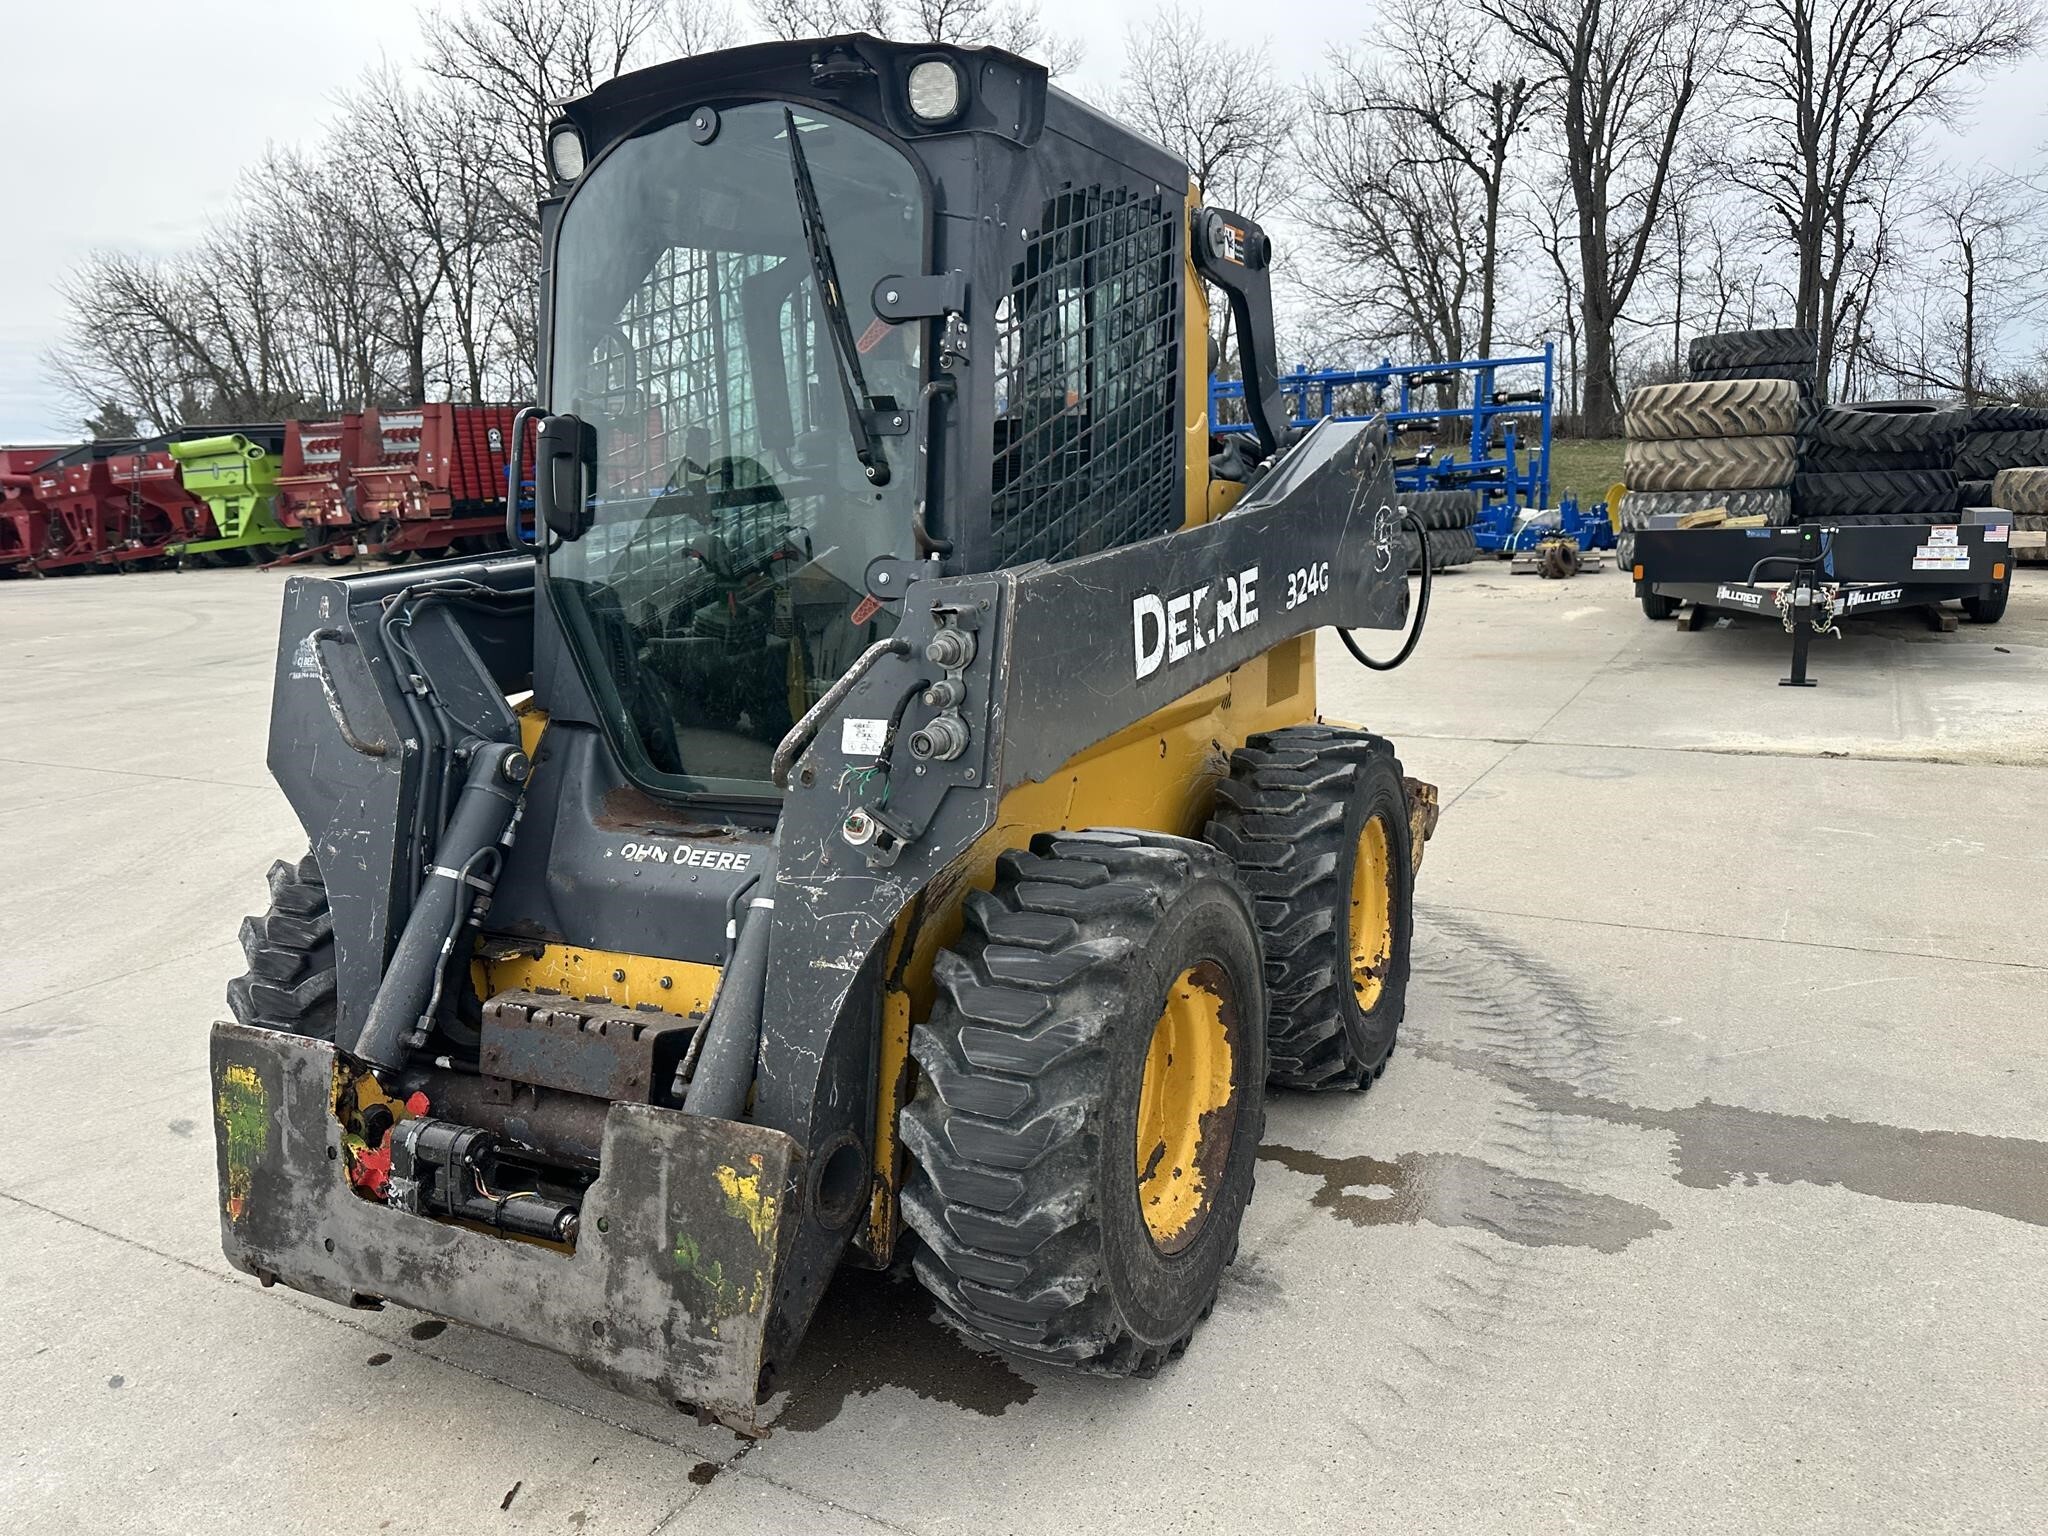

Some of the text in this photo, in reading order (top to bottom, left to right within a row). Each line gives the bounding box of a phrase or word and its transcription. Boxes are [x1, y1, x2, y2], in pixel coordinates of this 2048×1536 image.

[1286, 562, 1329, 610] 324G
[1846, 588, 1903, 606] HILLCREST
[604, 843, 751, 872] OHN DEERE
